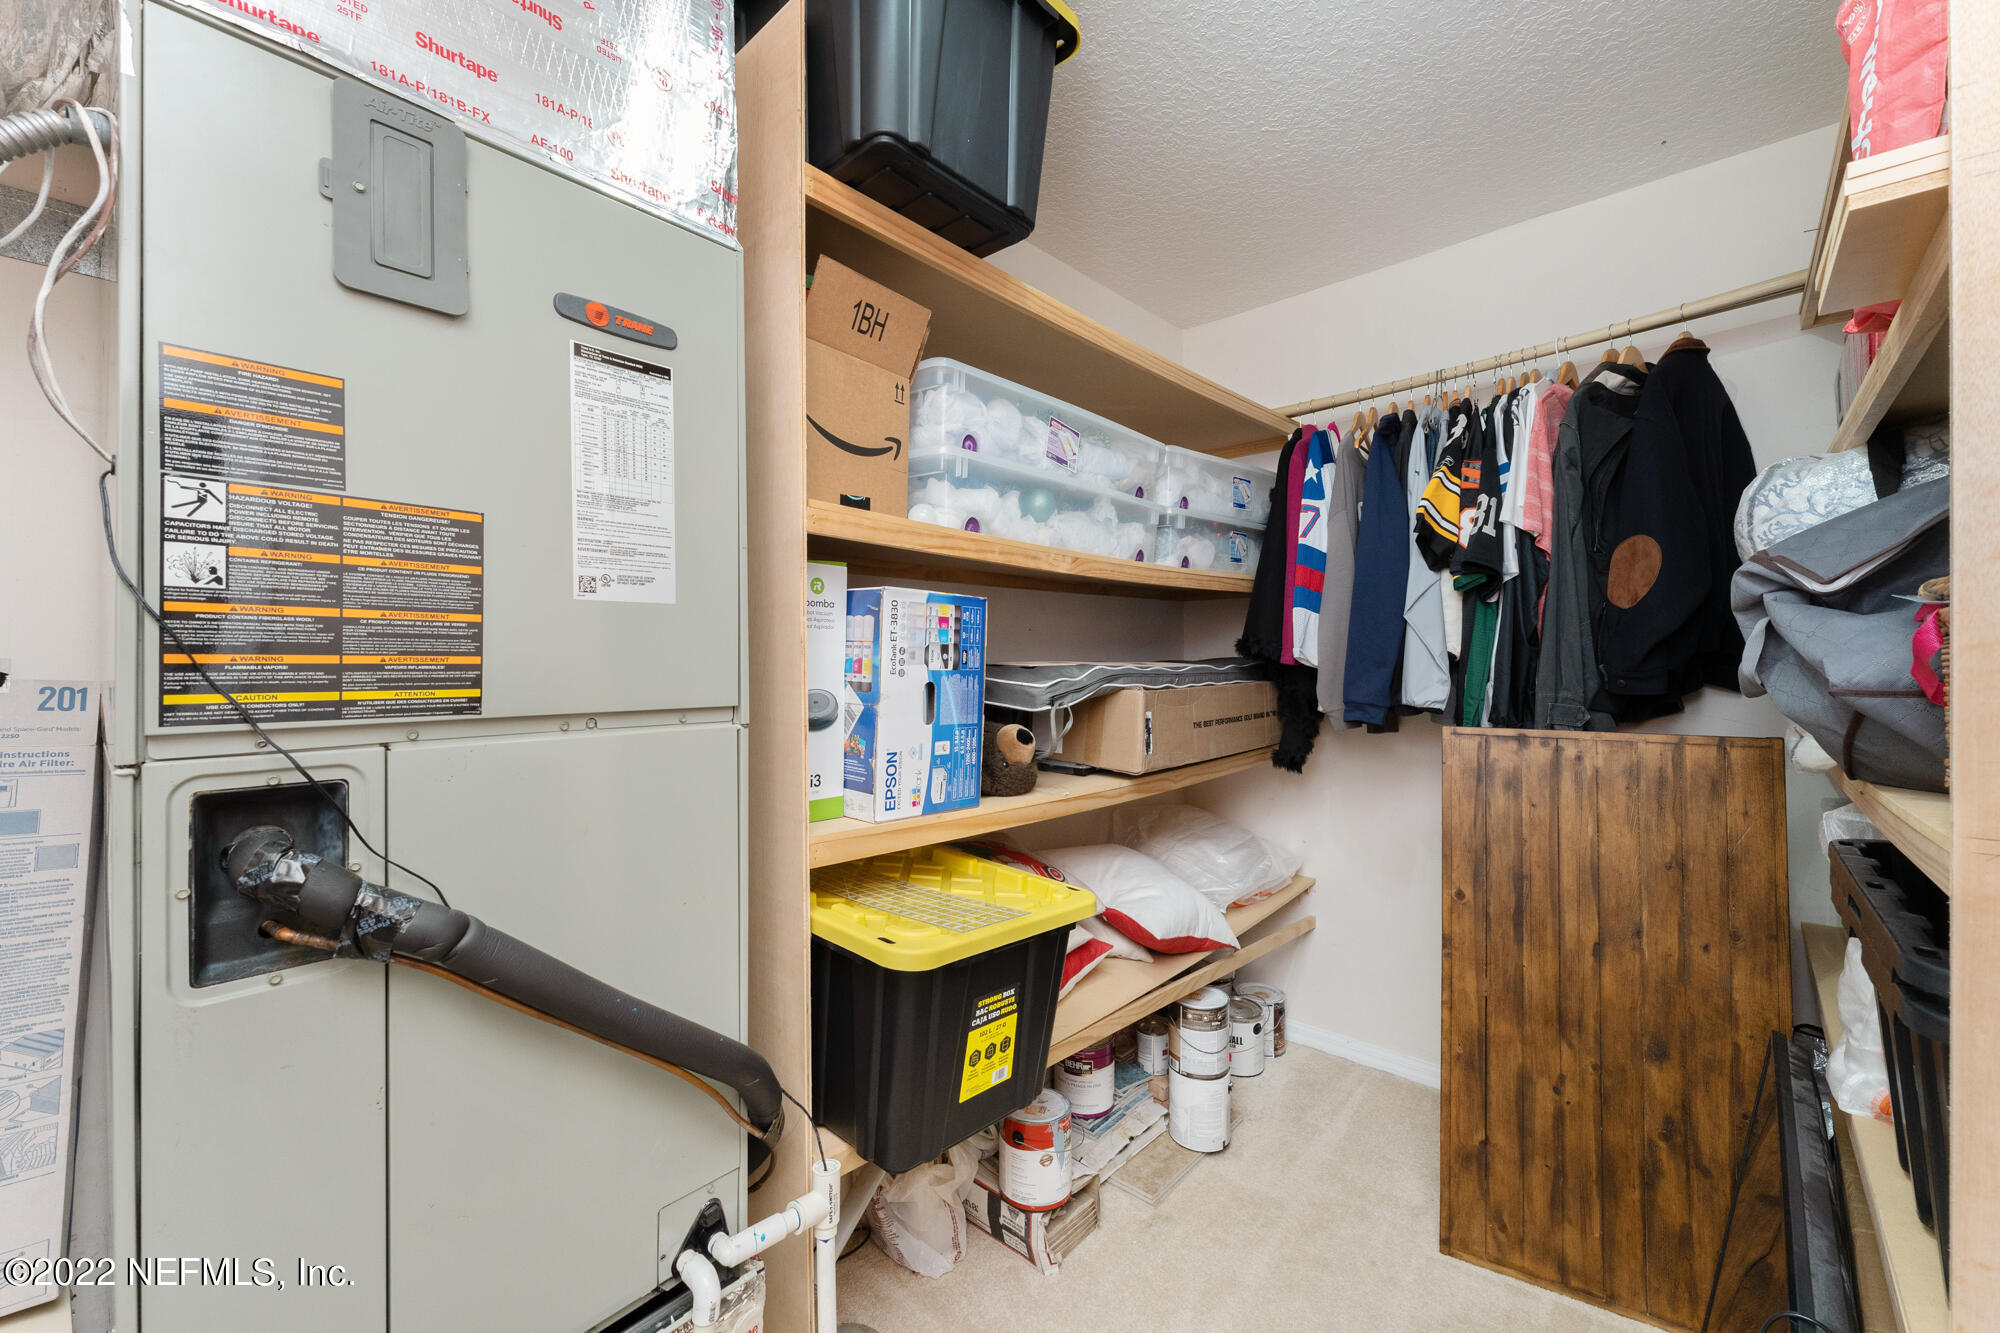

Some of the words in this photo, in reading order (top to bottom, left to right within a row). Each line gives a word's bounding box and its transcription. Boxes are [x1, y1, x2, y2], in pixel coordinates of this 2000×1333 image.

[415, 31, 498, 83] Shurtape
[369, 60, 491, 125] 181A-P/181B-FX
[615, 315, 655, 336] TRANE
[852, 299, 890, 342] 1BH
[241, 362, 285, 376] WARNING
[224, 409, 301, 426] AVERTISSEMENT
[270, 490, 312, 500] WARNING
[389, 503, 450, 517] AVERTISSEMENT
[270, 551, 311, 560] WARNING
[388, 560, 449, 570] AVERTISSEMENT
[890, 600, 899, 642] ET-3830
[890, 643, 898, 675] EcoTank
[37, 686, 88, 712] 201
[810, 774, 822, 788] i3
[884, 751, 898, 812] EPSON
[975, 1006, 989, 1017] BAC
[988, 996, 1016, 1012] ROBUSTE
[977, 992, 1003, 1008] STRONG
[1002, 988, 1016, 998] BOX
[971, 1015, 988, 1027] CAJA
[988, 1009, 1001, 1020] USO
[1000, 1003, 1018, 1015] RUDO
[1064, 1059, 1083, 1070] BEHR
